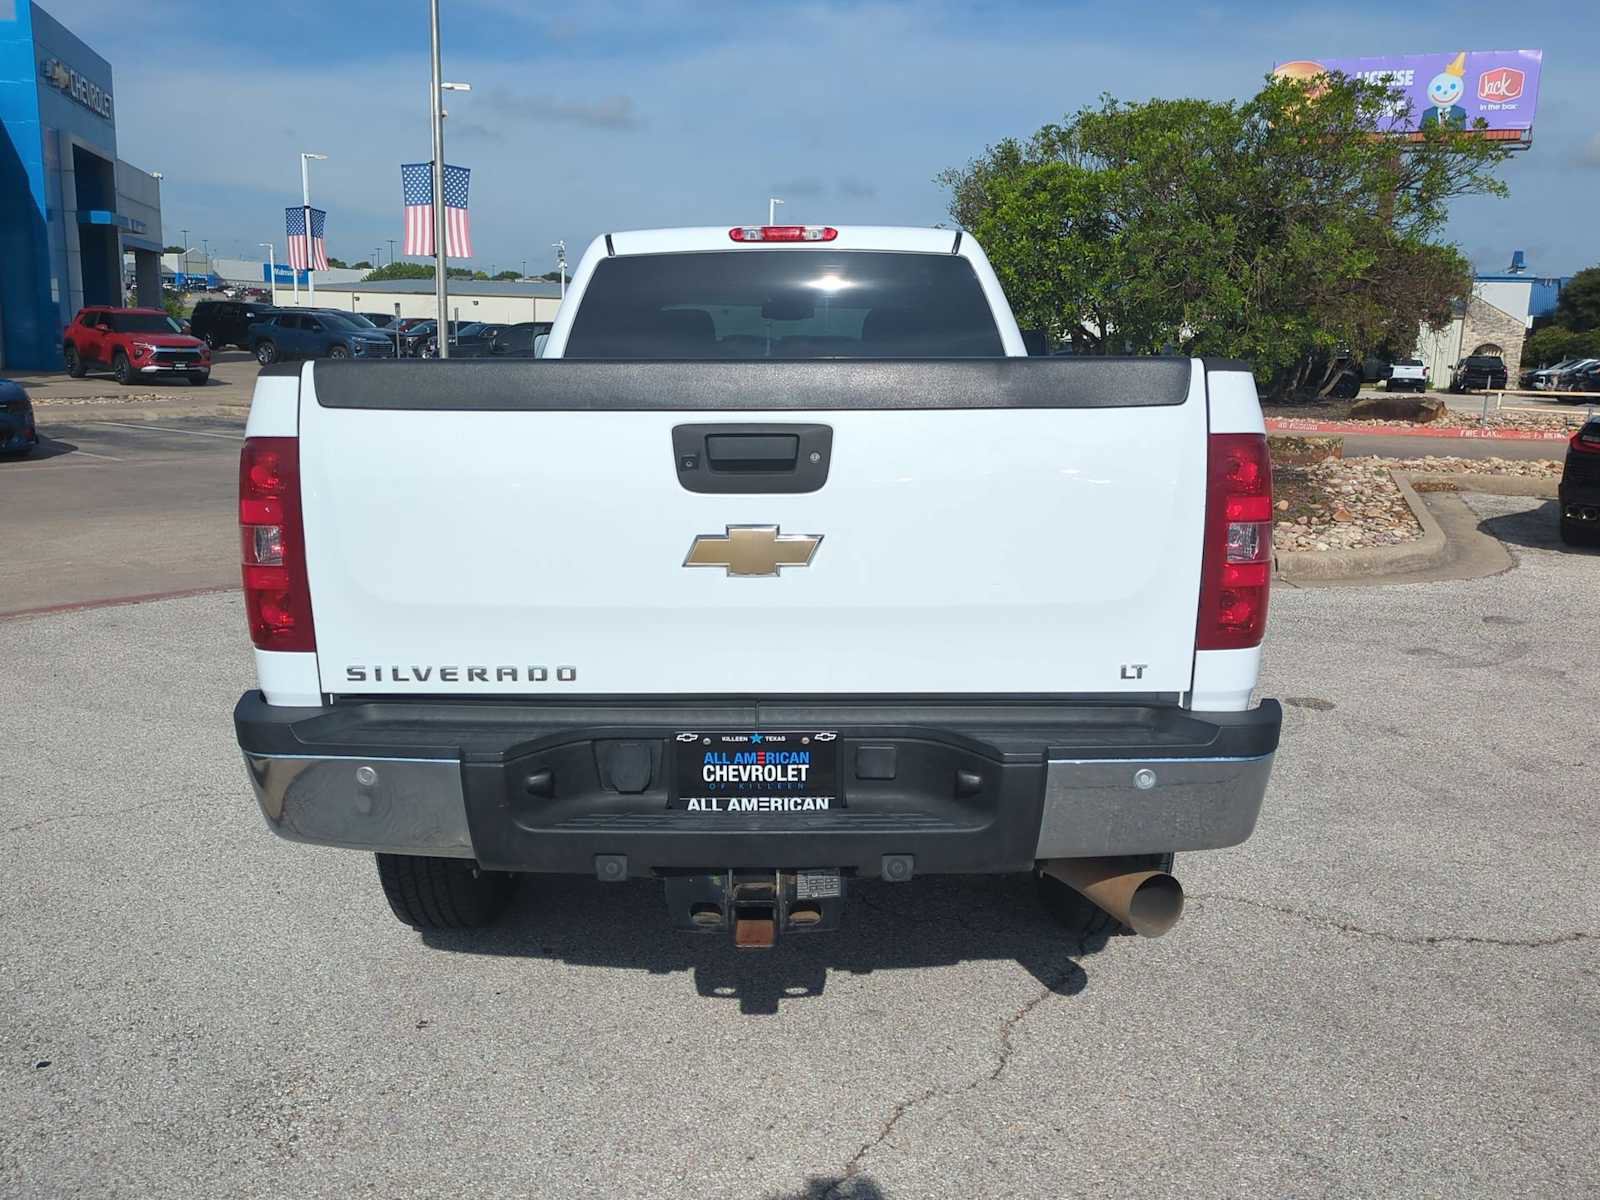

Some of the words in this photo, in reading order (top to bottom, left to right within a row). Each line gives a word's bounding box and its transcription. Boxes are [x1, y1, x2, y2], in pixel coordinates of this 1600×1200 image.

[1480, 71, 1521, 97] Jack
[70, 68, 113, 120] CHEVROLET
[346, 665, 577, 682] SILVERADO
[1120, 664, 1148, 680] LT
[704, 752, 730, 764] ALL
[734, 752, 810, 764] AMERICAN
[703, 765, 809, 782] CHEVROLET
[708, 782, 727, 790] OF
[739, 782, 804, 790] KILLEEN
[687, 798, 723, 811] ALL
[727, 798, 829, 811] AMERICAN
